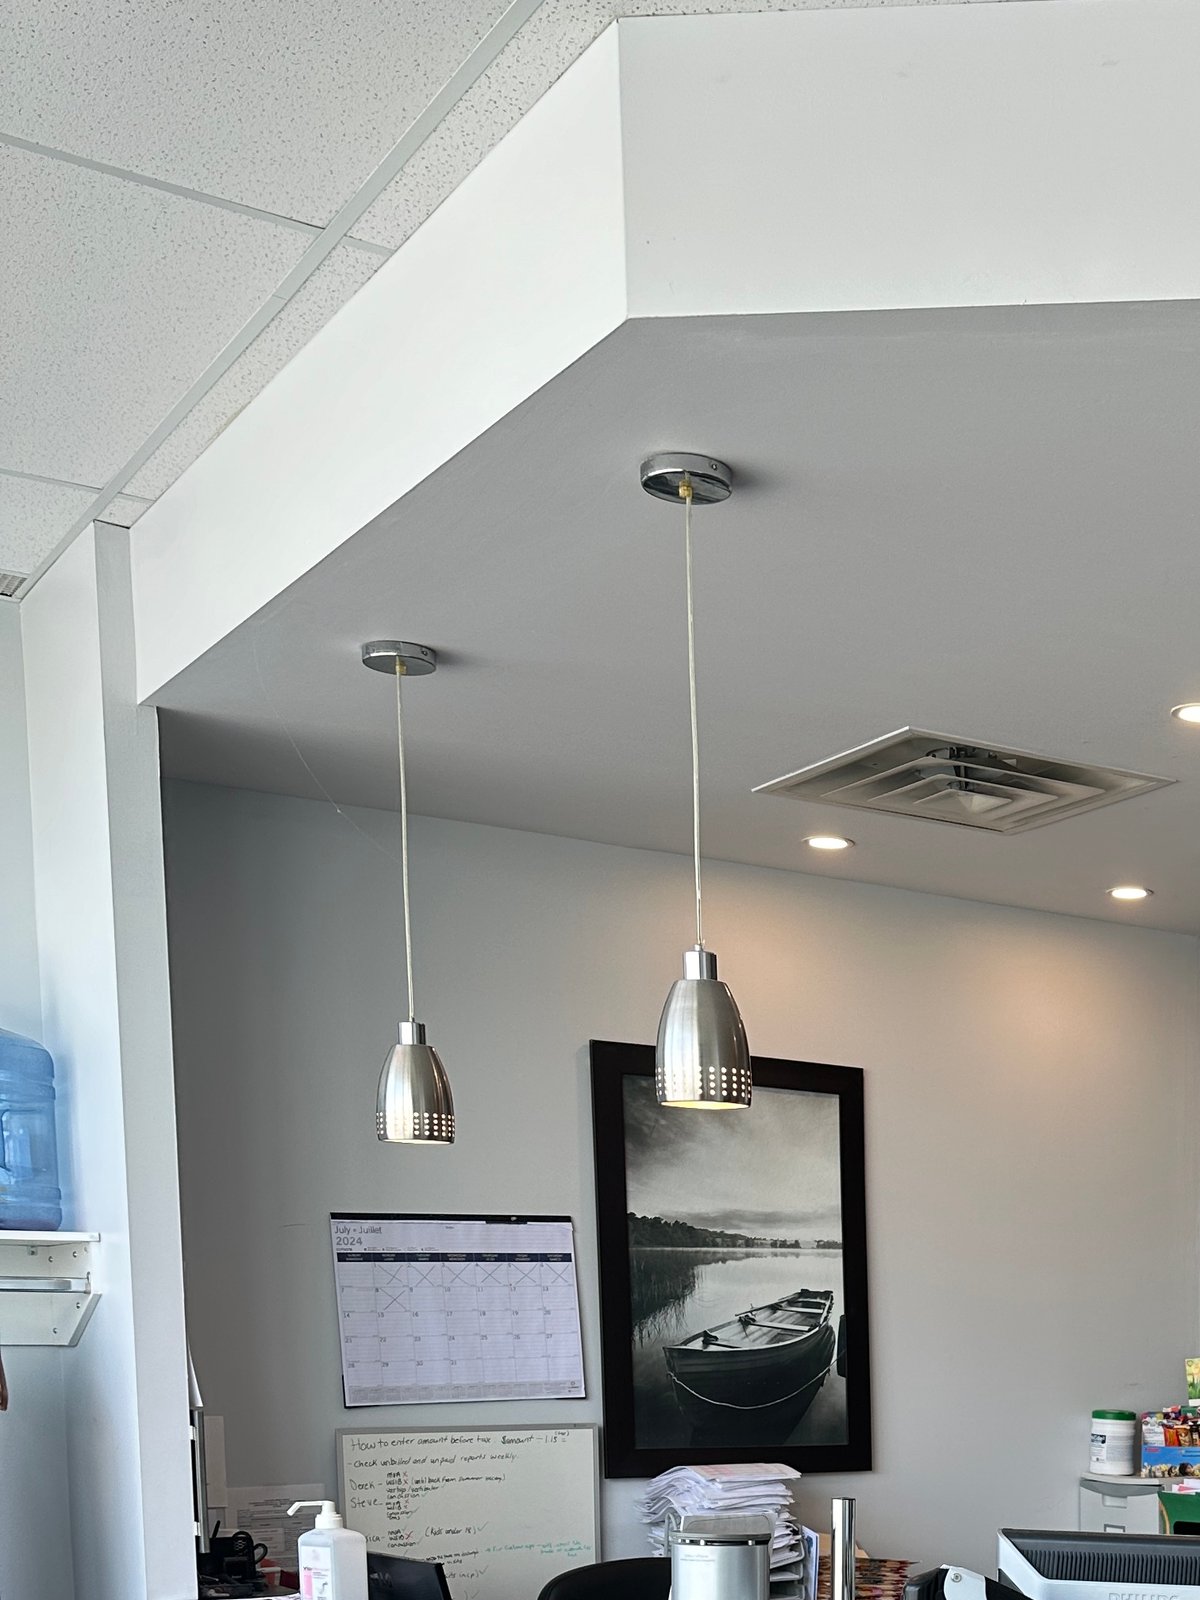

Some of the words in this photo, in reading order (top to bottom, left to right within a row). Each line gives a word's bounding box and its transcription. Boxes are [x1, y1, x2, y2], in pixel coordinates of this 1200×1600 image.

[334, 1226, 351, 1235] July
[358, 1226, 382, 1234] Juillet
[336, 1236, 363, 1246] 2024
[351, 1437, 376, 1451] How
[379, 1438, 389, 1447] to
[390, 1437, 415, 1447] enter
[417, 1436, 448, 1445] amount
[450, 1434, 474, 1445] before
[353, 1457, 378, 1468] Check
[412, 1456, 428, 1465] and
[430, 1455, 456, 1466] unpaid
[460, 1453, 486, 1463] reports
[350, 1497, 379, 1509] Steve
